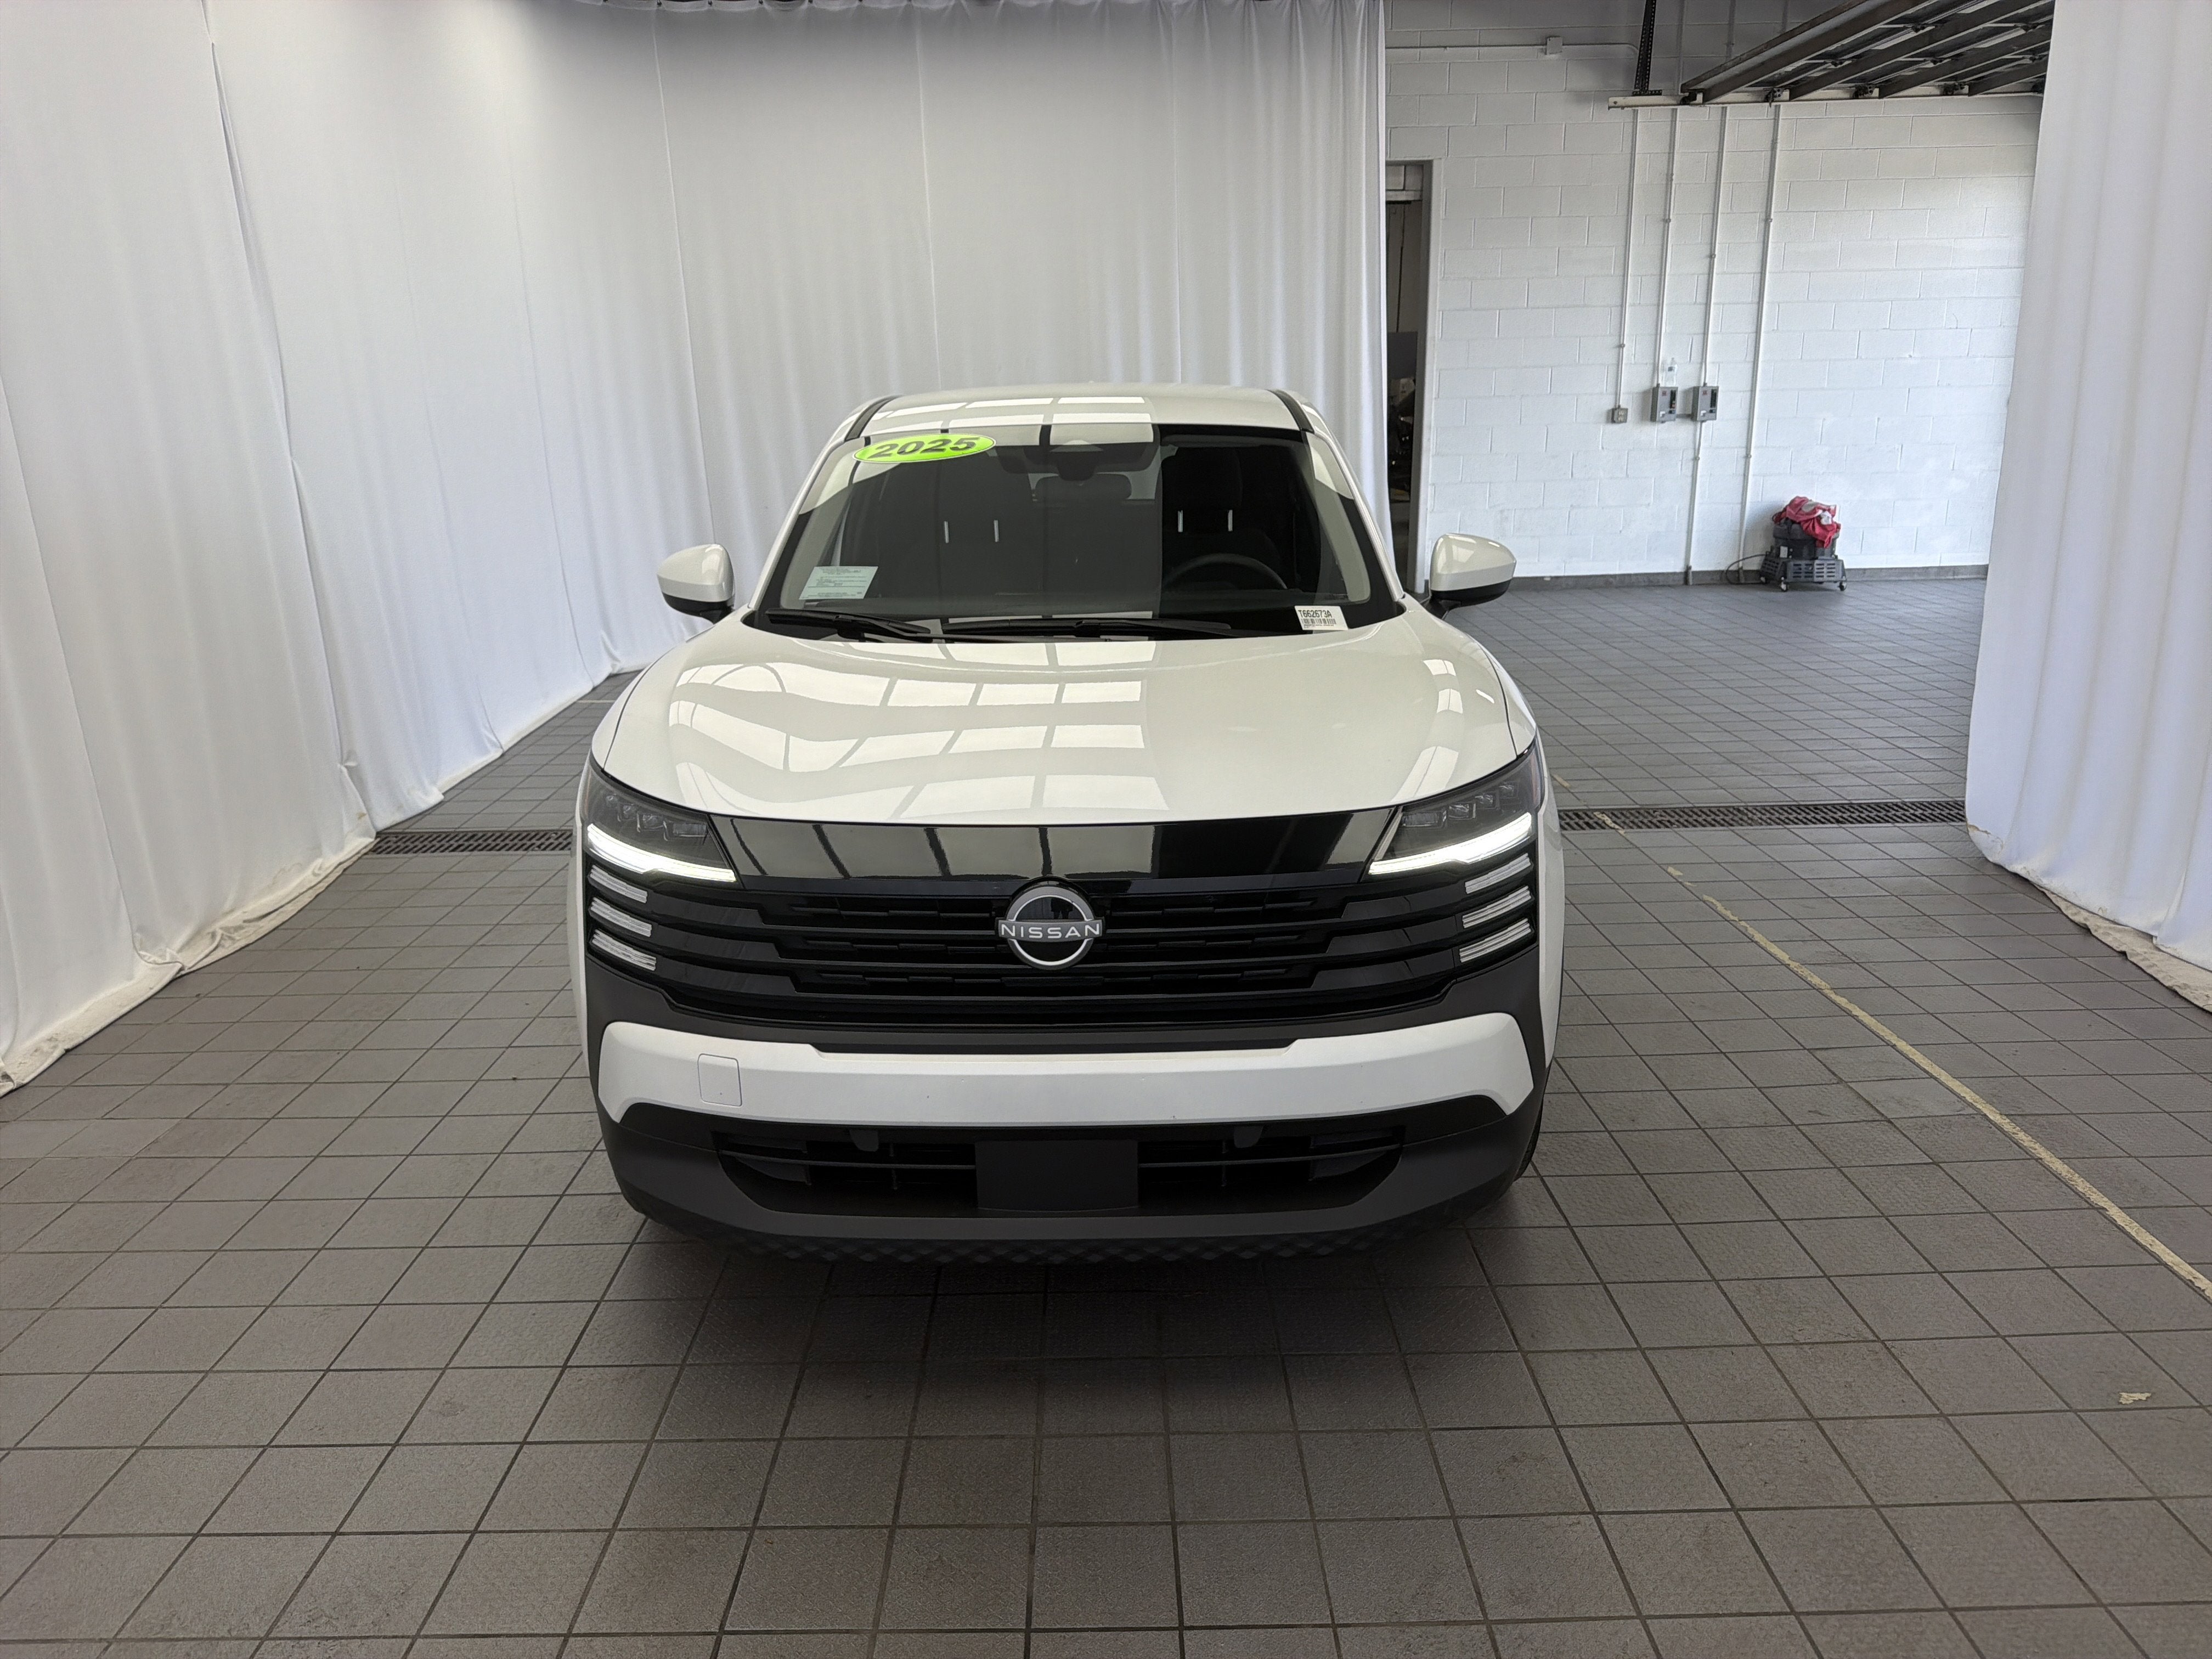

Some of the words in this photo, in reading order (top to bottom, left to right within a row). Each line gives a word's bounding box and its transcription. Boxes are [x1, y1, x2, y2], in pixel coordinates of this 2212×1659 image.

[867, 437, 980, 459] 2025
[1298, 610, 1332, 618] T662673A
[1001, 923, 1099, 939] NISSAN
